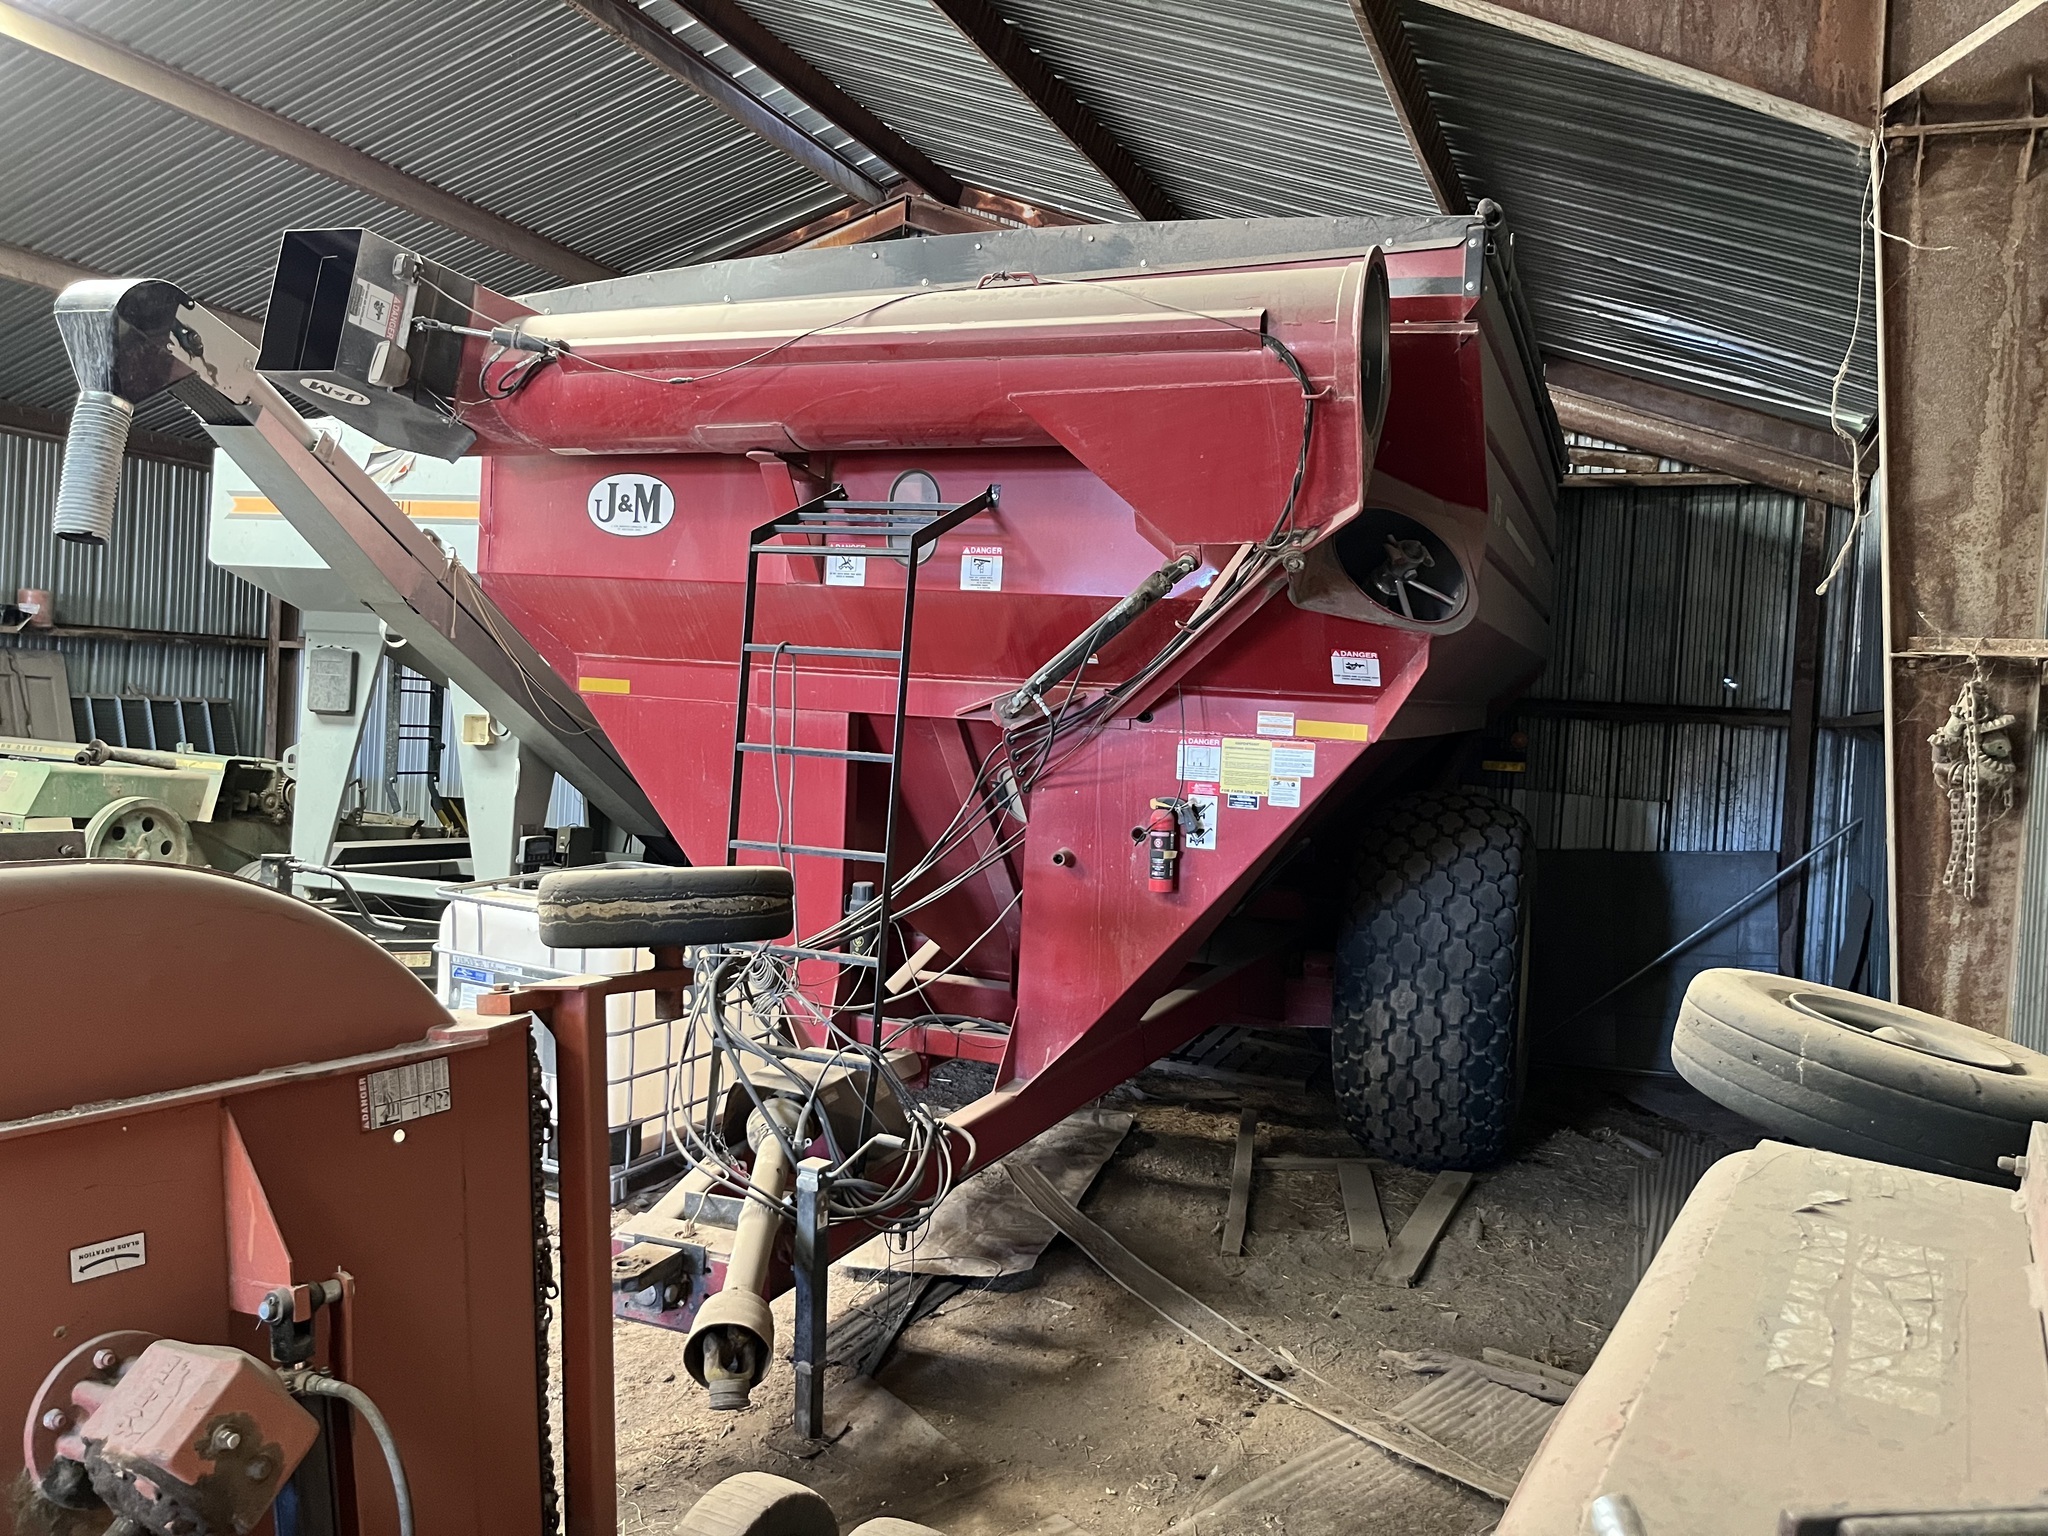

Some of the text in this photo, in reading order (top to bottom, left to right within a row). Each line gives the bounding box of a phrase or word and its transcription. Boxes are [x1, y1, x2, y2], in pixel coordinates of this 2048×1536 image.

[386, 304, 400, 340] DANGER
[309, 381, 364, 402] J&M
[595, 482, 663, 524] J&M
[970, 546, 1002, 555] DANGER
[1340, 650, 1378, 659] DANGER
[1188, 737, 1220, 746] DANGER
[359, 1077, 370, 1121] DANGER
[78, 1246, 115, 1260] ROTATION
